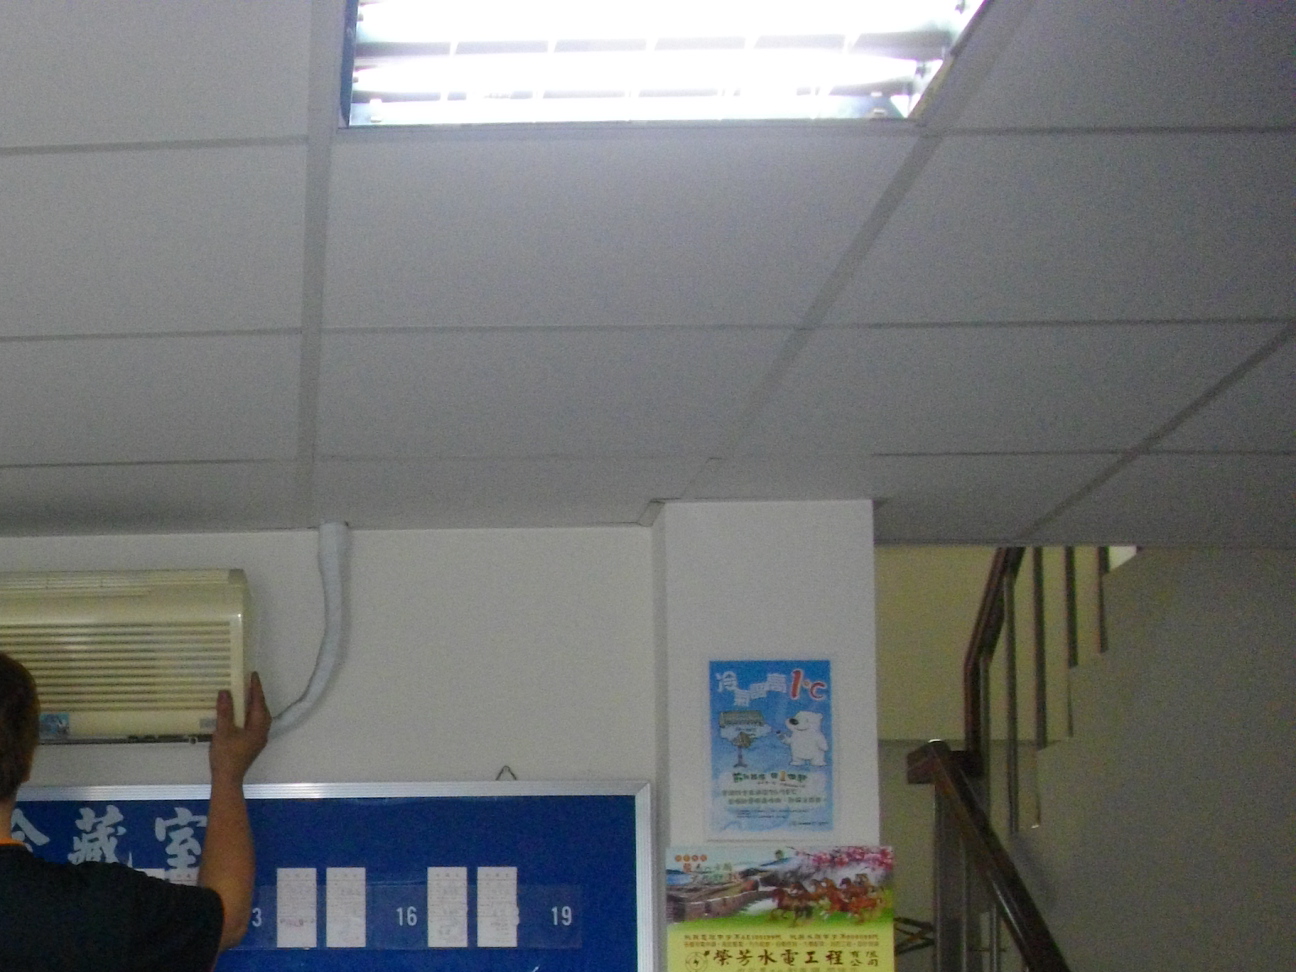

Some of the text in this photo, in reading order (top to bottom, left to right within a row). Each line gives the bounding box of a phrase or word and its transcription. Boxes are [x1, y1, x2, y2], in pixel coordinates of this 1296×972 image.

[252, 908, 262, 927] 3
[397, 906, 418, 926] 16
[552, 905, 572, 926] 19
